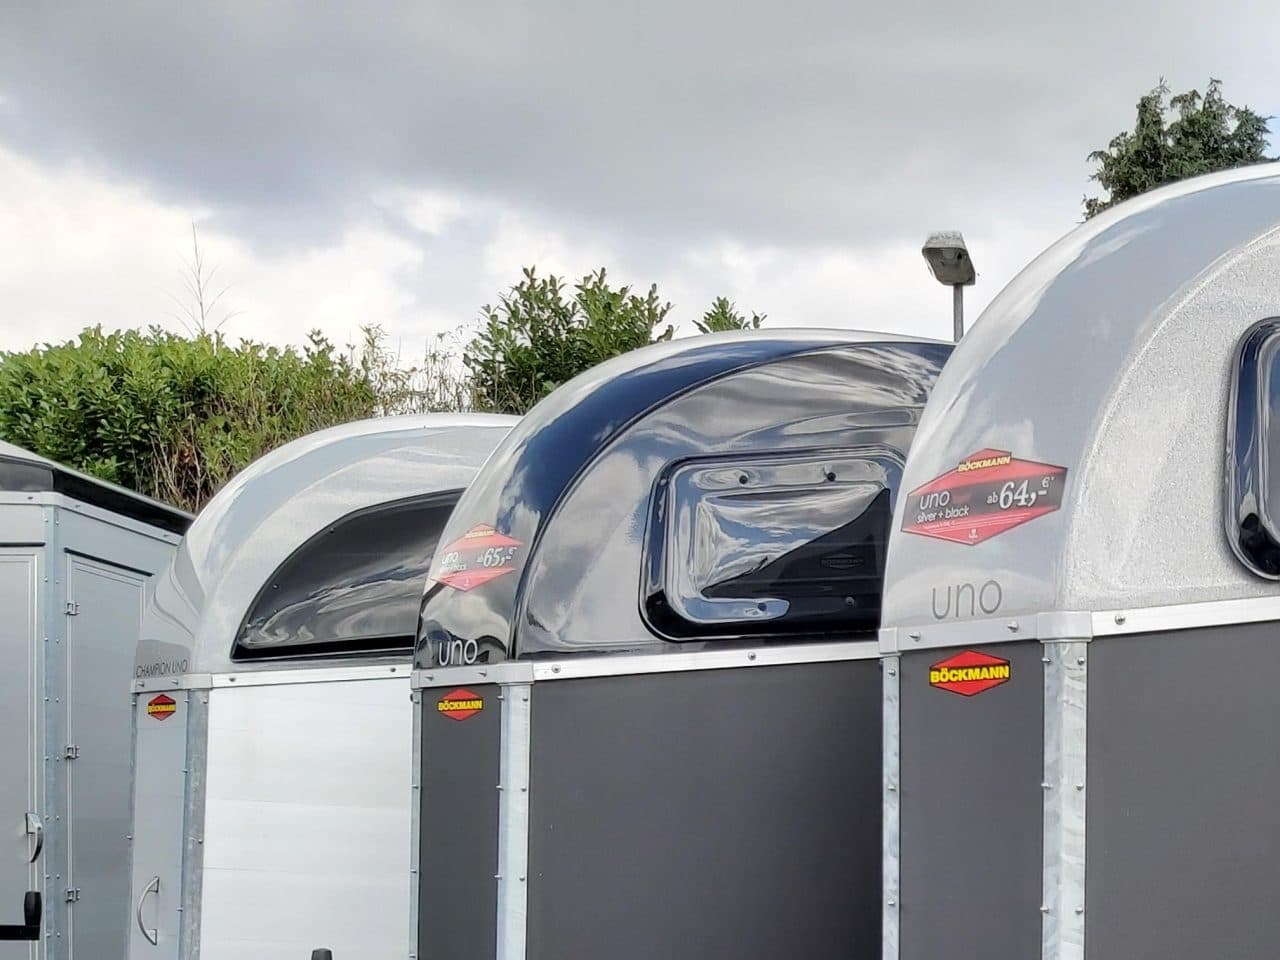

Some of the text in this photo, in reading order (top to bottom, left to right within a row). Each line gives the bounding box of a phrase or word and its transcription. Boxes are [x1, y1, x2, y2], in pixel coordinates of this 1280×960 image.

[919, 491, 950, 510] uno
[987, 492, 998, 504] ab
[917, 512, 937, 524] silver
[945, 505, 970, 519] black
[932, 580, 1002, 620] uno
[438, 638, 478, 666] uno
[930, 664, 1010, 683] BÖCKMANN
